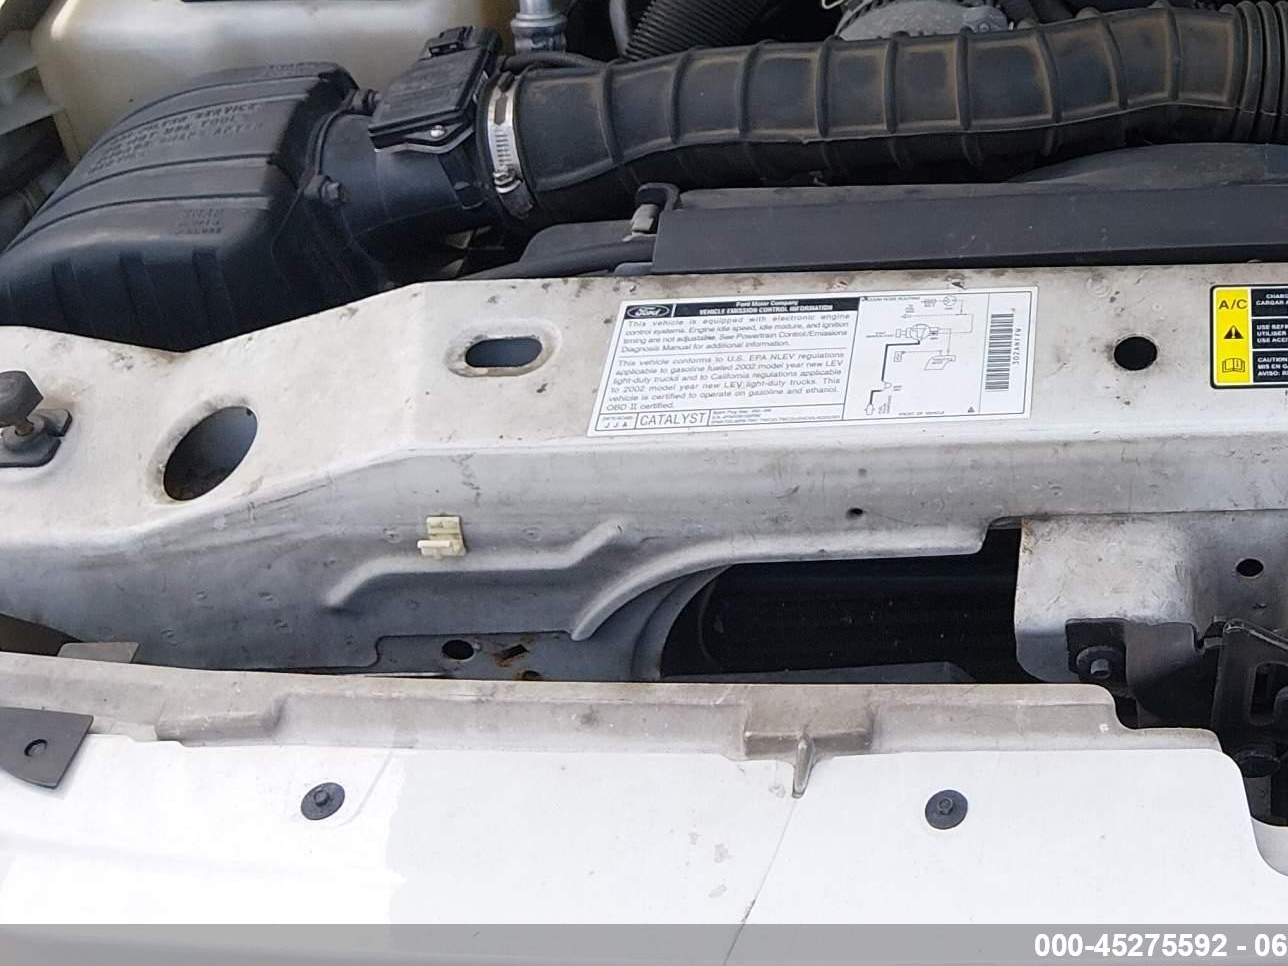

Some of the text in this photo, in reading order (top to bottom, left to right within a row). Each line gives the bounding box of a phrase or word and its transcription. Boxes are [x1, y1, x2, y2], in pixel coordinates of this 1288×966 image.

[1219, 299, 1248, 310] A/C
[635, 306, 661, 316] Ford
[640, 413, 706, 426] CATALYST
